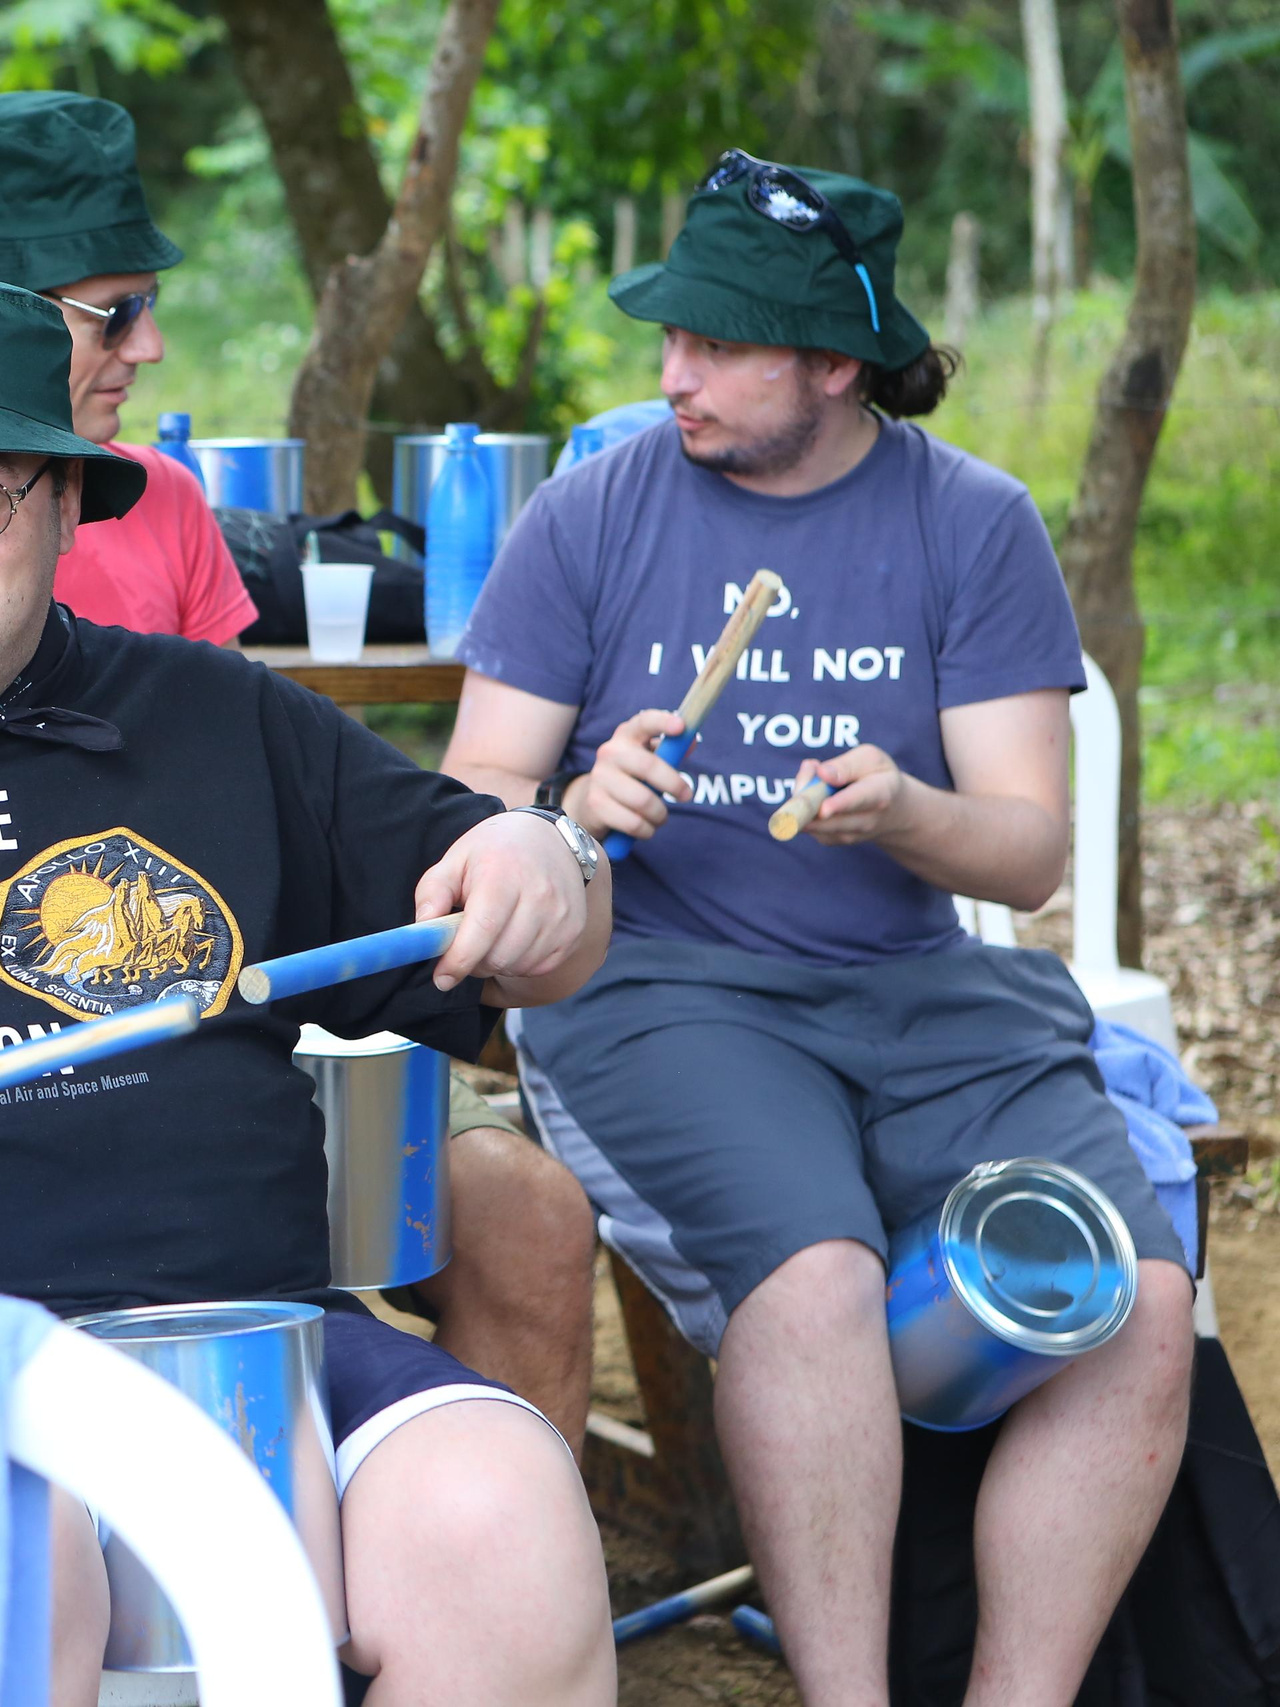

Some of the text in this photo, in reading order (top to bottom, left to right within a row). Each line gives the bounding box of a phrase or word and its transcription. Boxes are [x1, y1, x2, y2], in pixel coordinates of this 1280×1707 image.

[648, 642, 663, 675] I
[813, 646, 905, 681] NOT
[737, 712, 860, 747] YOUR
[17, 840, 182, 902] APOLLO XIII
[1, 934, 114, 1016] EX LUNA, SCIENTIA
[15, 1085, 34, 1103] Air
[37, 1081, 59, 1100] and
[61, 1078, 98, 1100] Space
[101, 1072, 150, 1091] Museum
